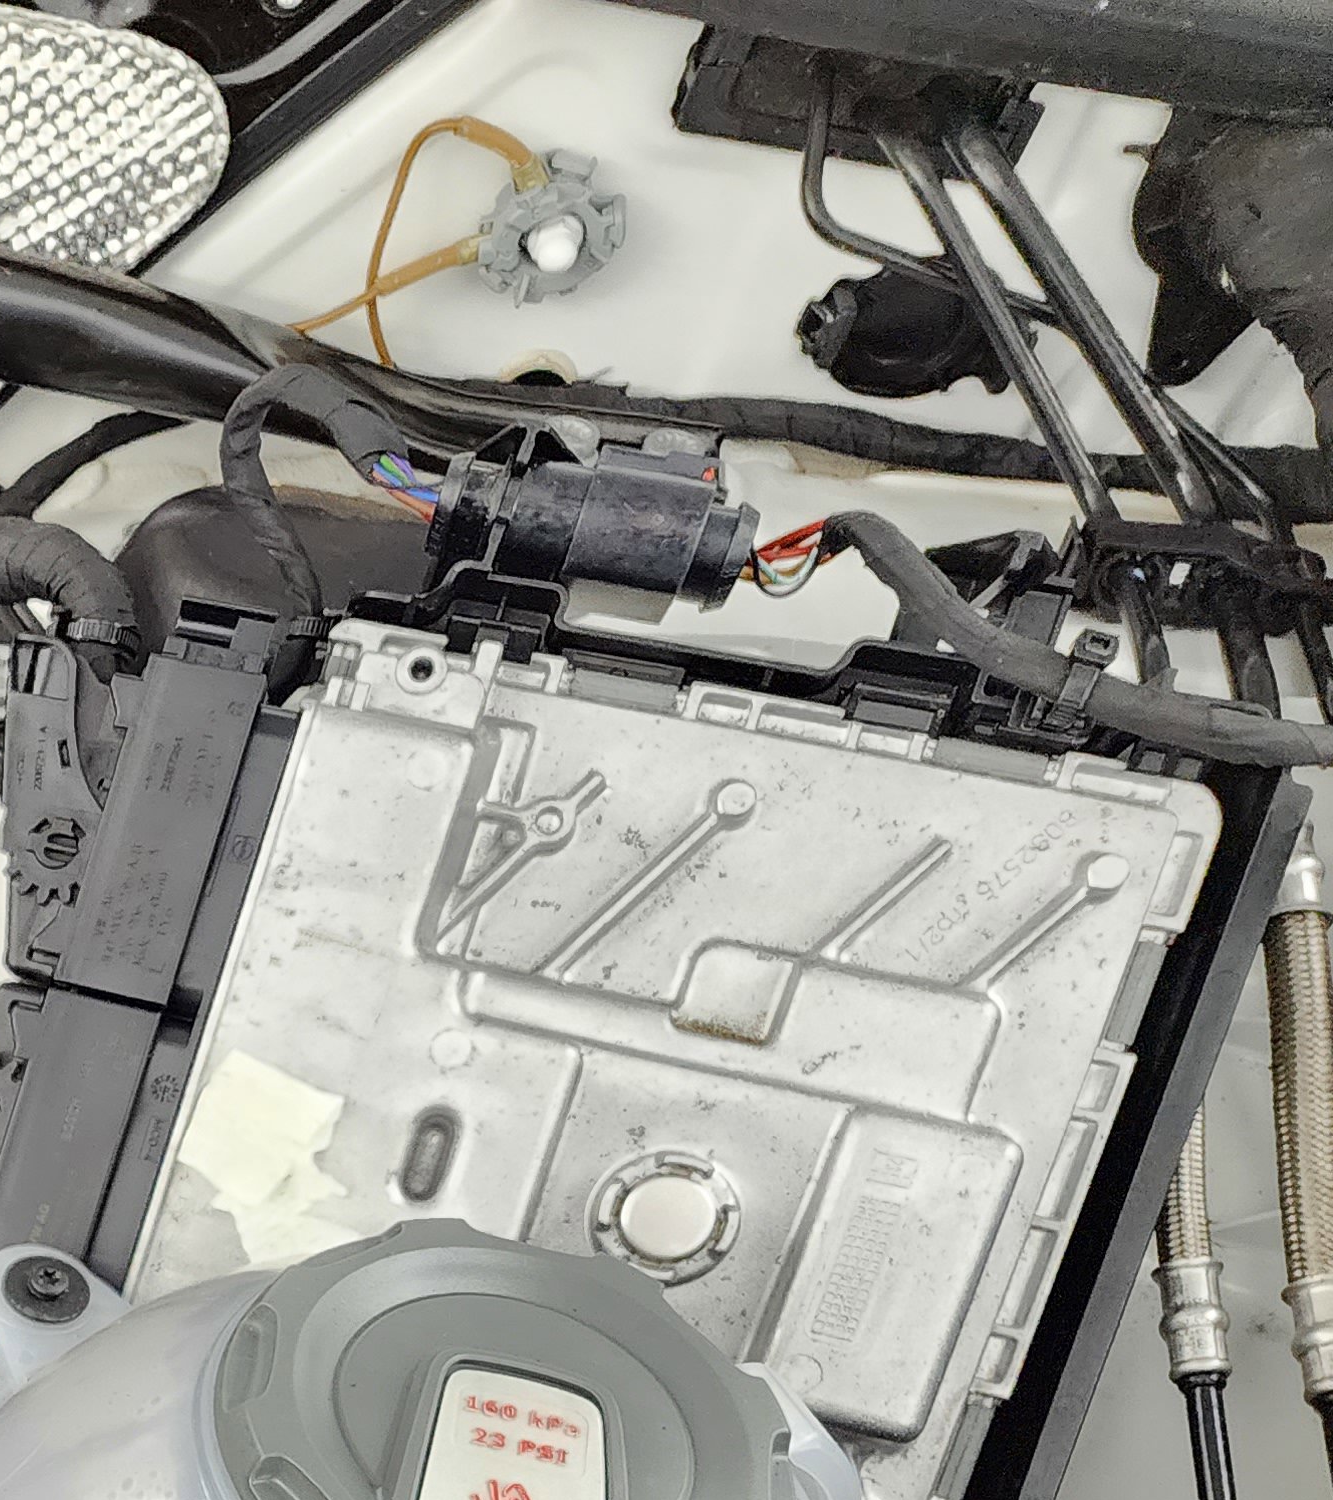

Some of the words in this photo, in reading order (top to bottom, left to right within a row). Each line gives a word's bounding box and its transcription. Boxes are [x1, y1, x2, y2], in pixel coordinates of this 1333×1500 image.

[465, 1394, 518, 1421] 160
[529, 1410, 580, 1438] kPa
[470, 1427, 506, 1450] 23
[517, 1438, 570, 1466] PSI
